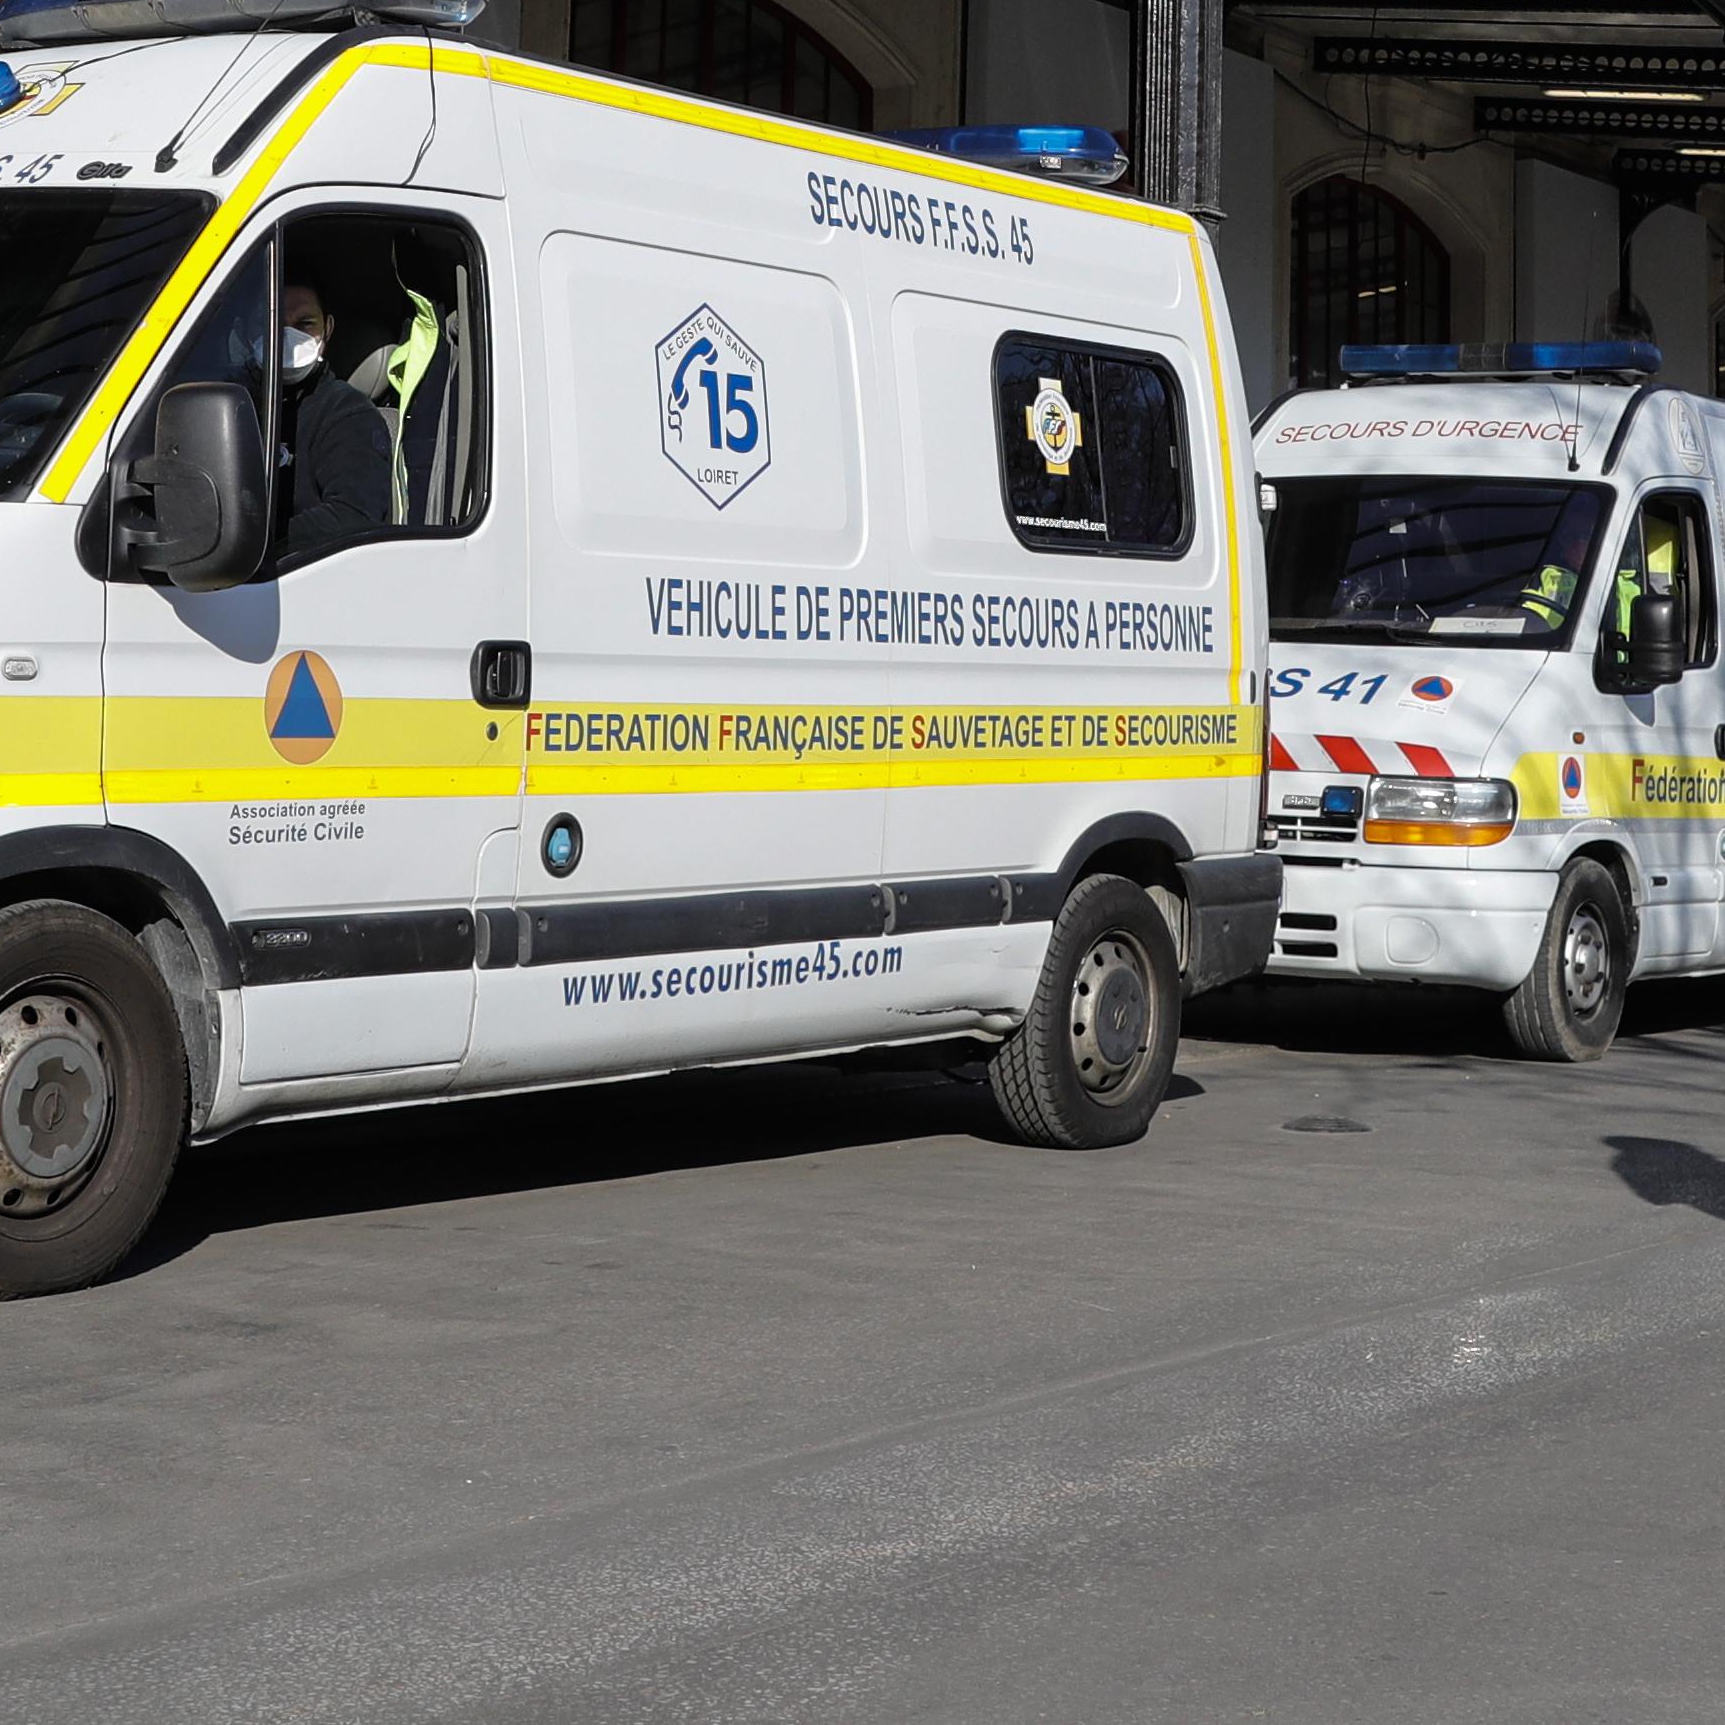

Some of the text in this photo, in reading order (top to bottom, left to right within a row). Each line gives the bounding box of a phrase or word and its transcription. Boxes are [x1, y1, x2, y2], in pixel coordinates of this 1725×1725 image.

[14, 154, 64, 184] 45
[807, 172, 1034, 265] SECOURS F.F.S.S. 45
[663, 316, 757, 373] LE GESTE QUI SAUVE
[699, 369, 759, 453] 15
[1275, 420, 1584, 444] SECOURS D'URGENCE
[697, 468, 739, 485] LOIRET
[1016, 515, 1107, 532] www.secourisme45.com
[645, 577, 1213, 653] VEHICULE DE PREMIERS SECOURS A PERSONNE
[1267, 668, 1389, 705] S 41
[525, 713, 1237, 760] FEDERATION FRANÇAISE DE SAUVETAGE ET DE SECOURISME
[229, 799, 366, 819] Association agréée
[228, 822, 364, 845] Sécurité Civile
[563, 941, 903, 1006] www.secourisme45.com
